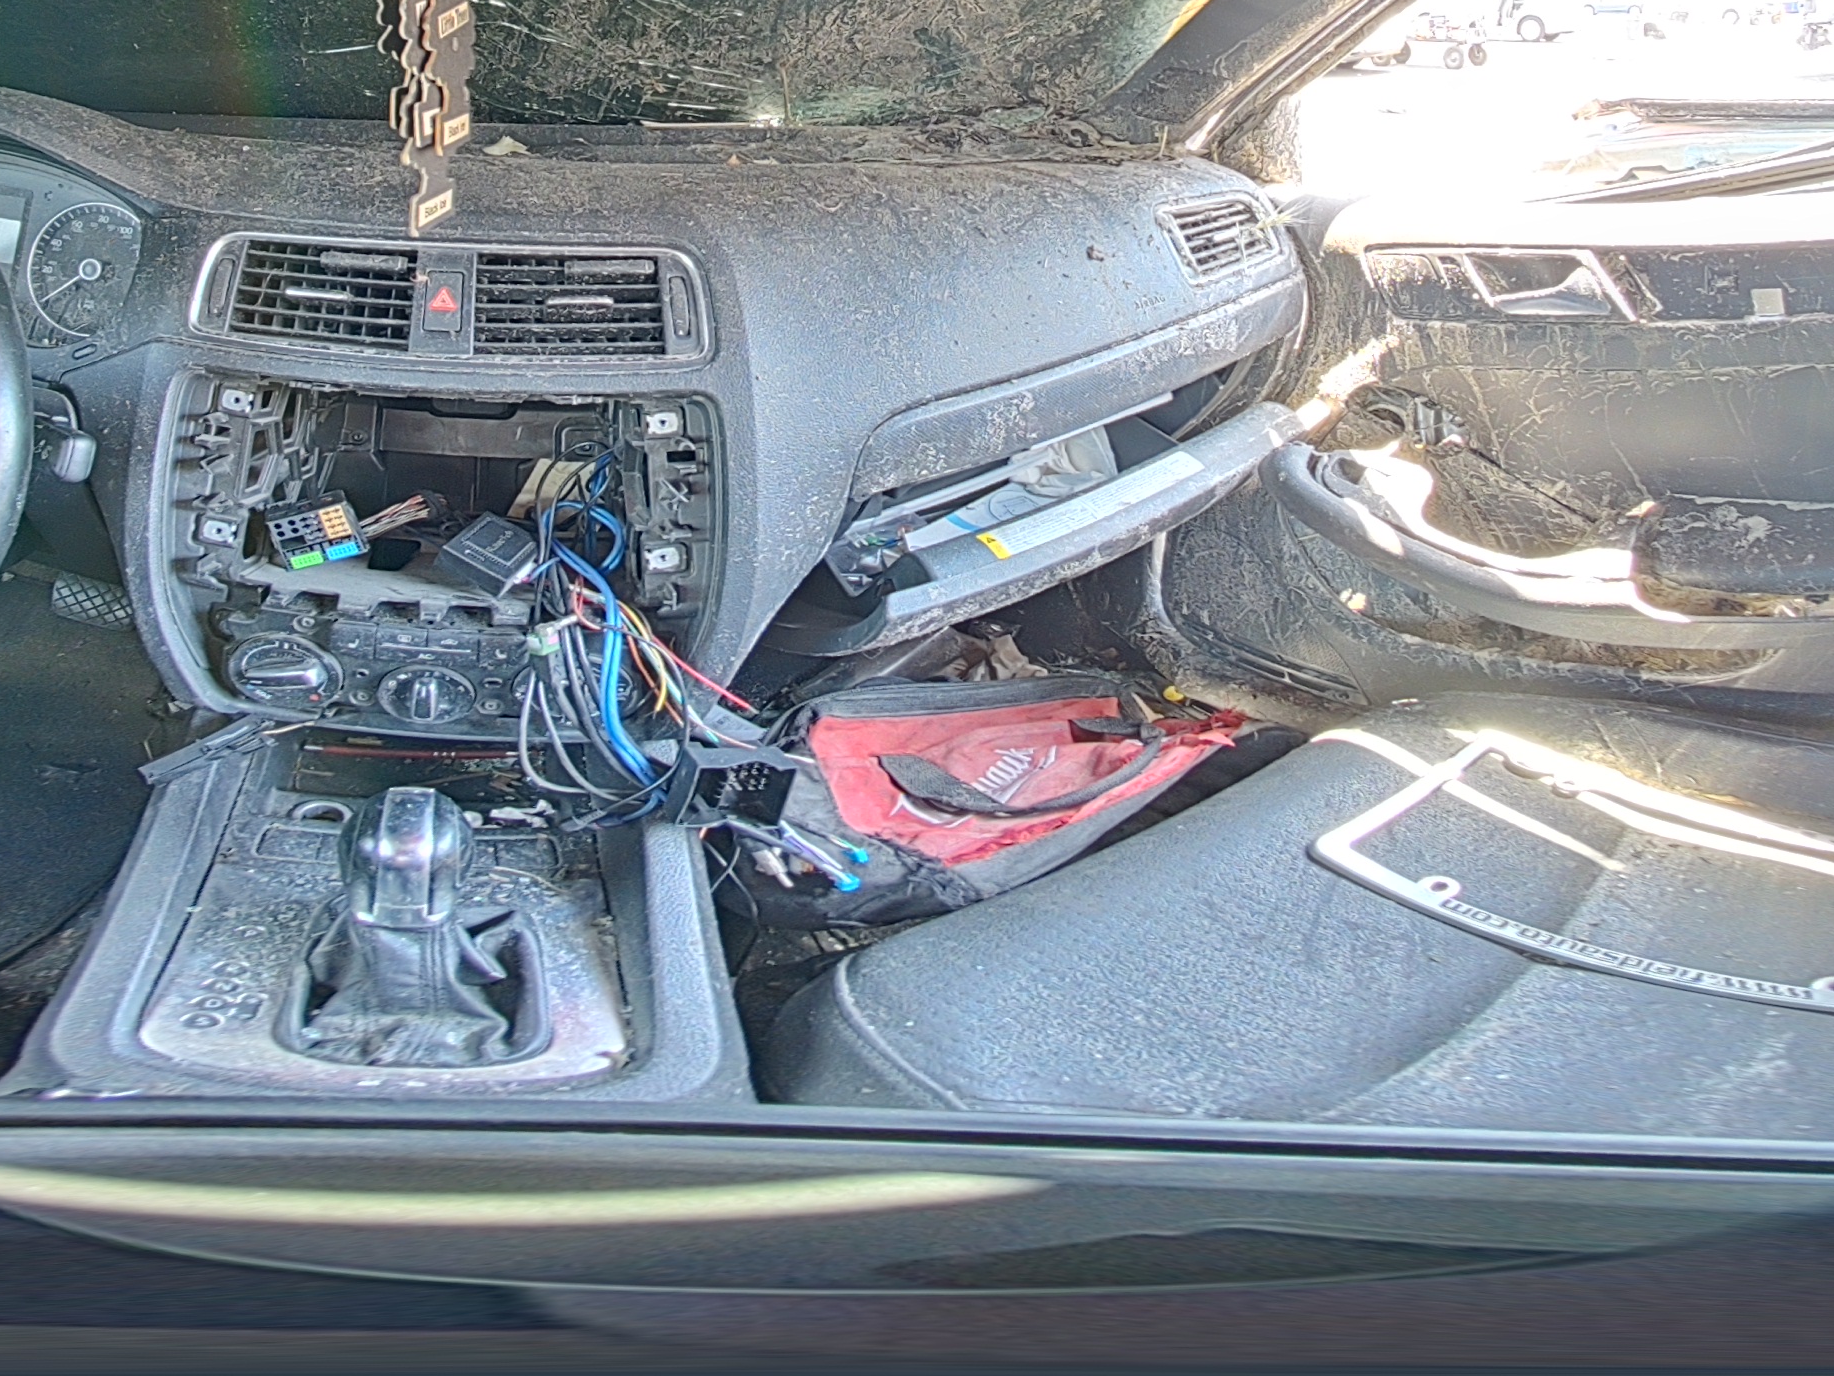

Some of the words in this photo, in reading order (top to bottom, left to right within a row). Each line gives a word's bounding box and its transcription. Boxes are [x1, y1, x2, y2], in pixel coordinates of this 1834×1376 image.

[119, 226, 134, 235] 100
[50, 238, 63, 247] 40
[41, 265, 53, 274] 20
[1133, 295, 1166, 310] AIRBAG
[1440, 898, 1816, 1001] www.fieldsauto.com
